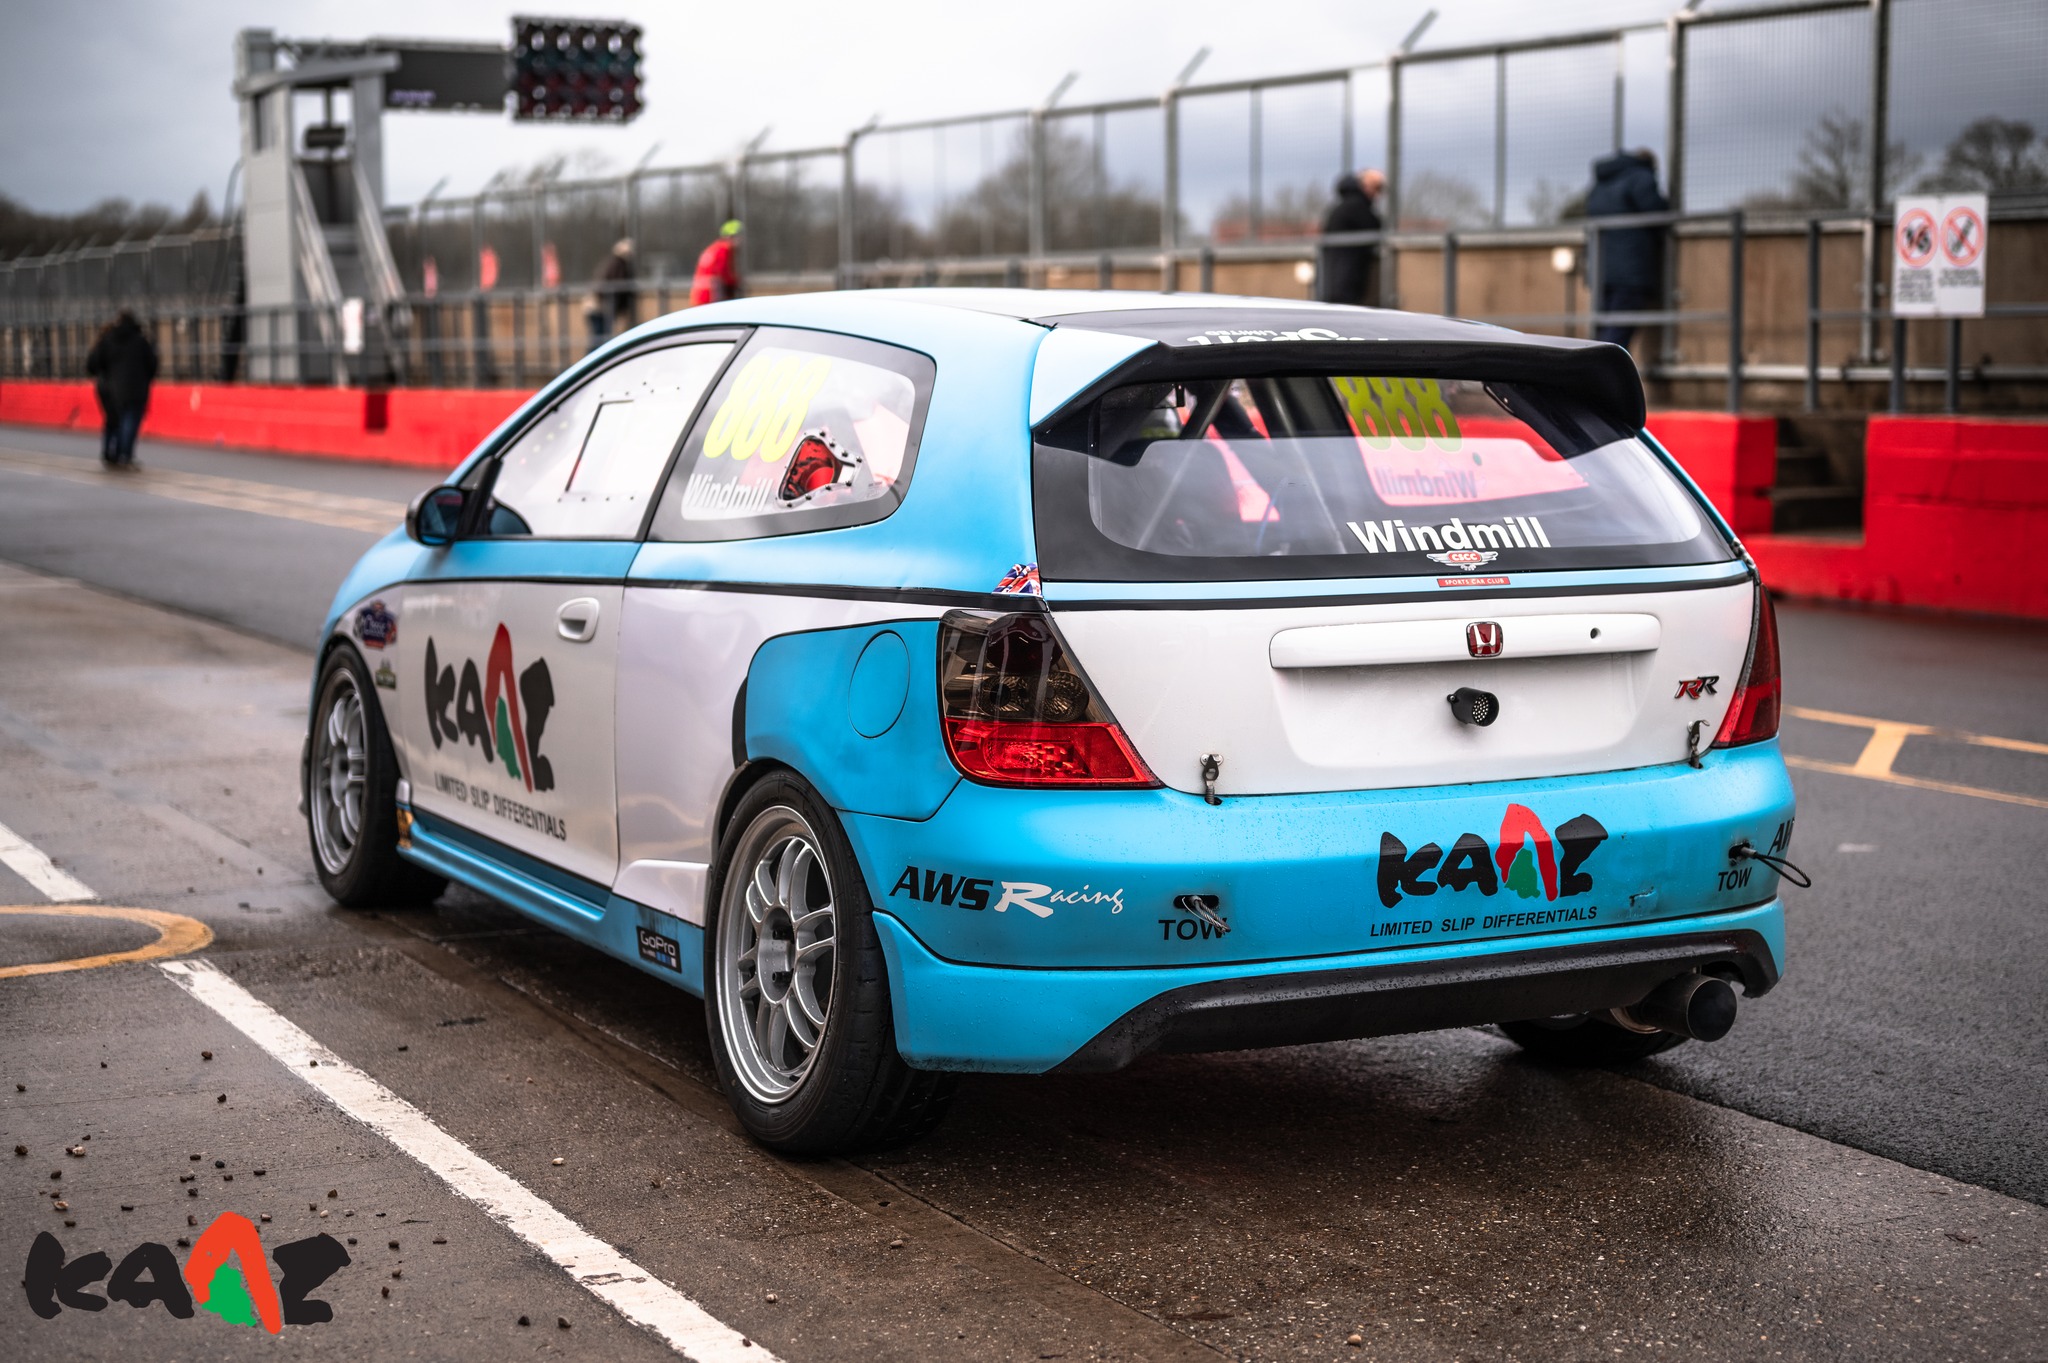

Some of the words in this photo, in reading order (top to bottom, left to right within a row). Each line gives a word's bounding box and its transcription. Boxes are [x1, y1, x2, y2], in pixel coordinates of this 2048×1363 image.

[703, 355, 832, 463] 888
[685, 473, 773, 512] Windmill
[1346, 517, 1551, 553] Windmill
[1451, 553, 1478, 561] CSCC
[1674, 675, 1720, 700] RR
[435, 773, 467, 802] LIMITED
[471, 787, 490, 810] SLIP
[494, 794, 567, 841] DIFFERENTIALS
[889, 865, 994, 911] AWS
[994, 881, 1124, 918] Racing
[1718, 867, 1752, 891] TOW
[1158, 919, 1227, 940] TOW
[1370, 920, 1433, 937] LIMITED
[1441, 917, 1475, 932] SLIP
[1483, 906, 1598, 929] DIFFERENTIALS
[640, 930, 677, 957] GoPro
